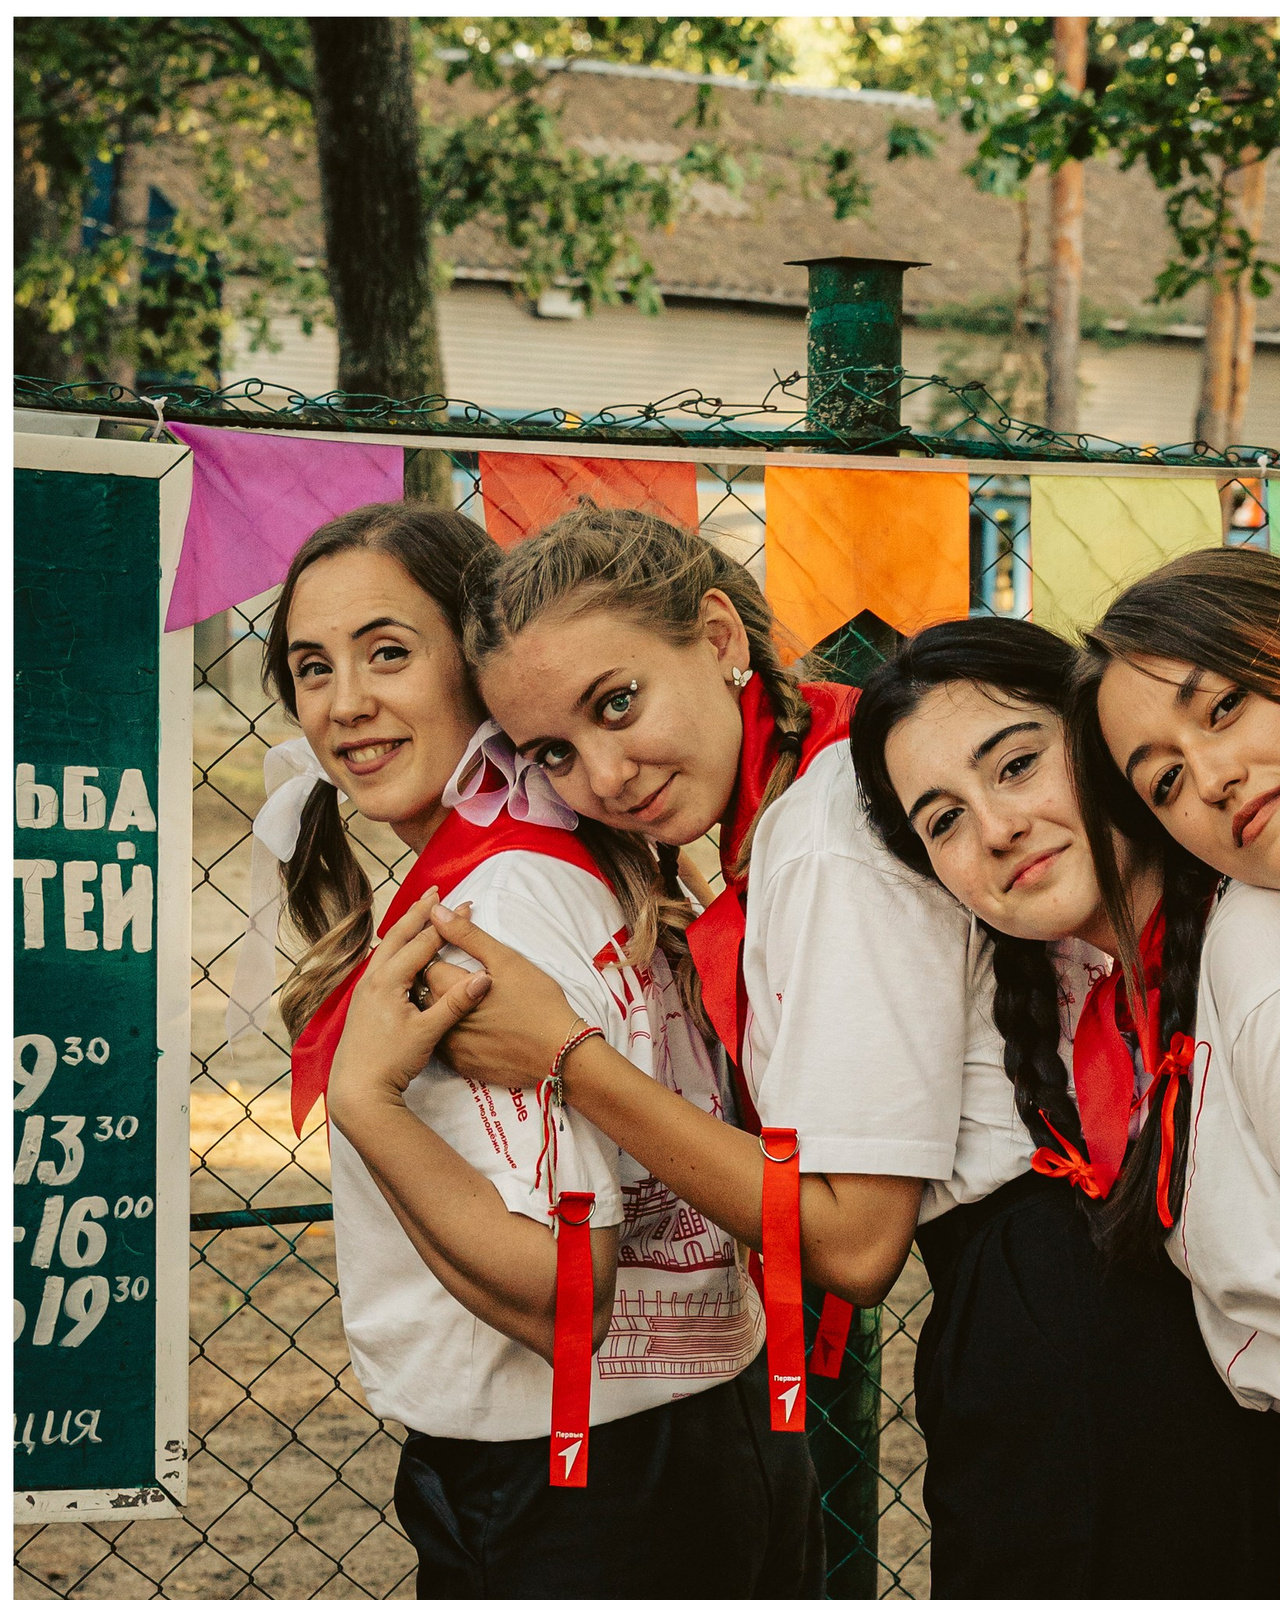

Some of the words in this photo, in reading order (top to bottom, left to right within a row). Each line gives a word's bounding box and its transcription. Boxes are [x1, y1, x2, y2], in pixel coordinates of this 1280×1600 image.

[16, 763, 157, 832] ЬБА
[14, 841, 154, 953] ТЕЙ
[474, 1095, 481, 1103] и
[774, 1375, 801, 1383] Первые
[555, 1431, 584, 1439] Первые
